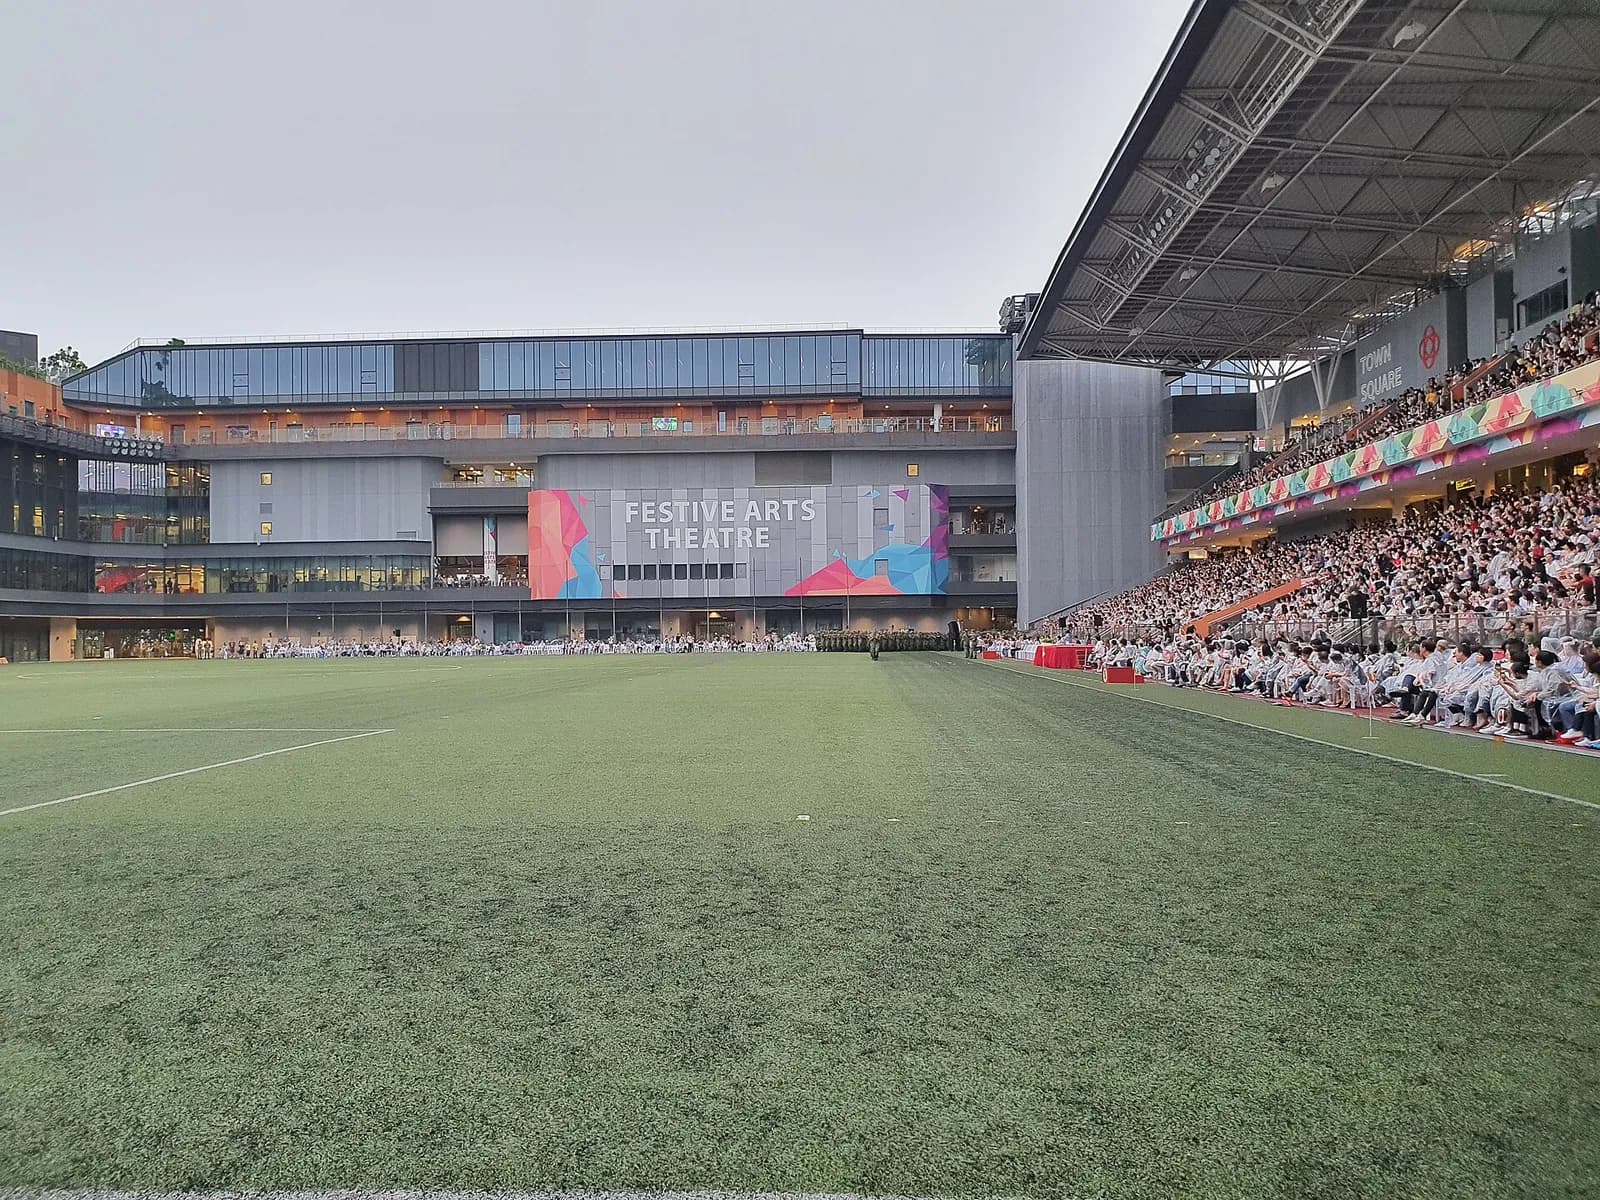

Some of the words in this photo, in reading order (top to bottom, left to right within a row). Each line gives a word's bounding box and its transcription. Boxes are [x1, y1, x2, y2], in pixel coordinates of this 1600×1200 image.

[1360, 342, 1392, 374] TOWN
[1361, 366, 1402, 402] SQUARE
[625, 501, 735, 523] FESTIVE
[744, 499, 816, 521] ARTS
[645, 527, 770, 549] THEATRE
